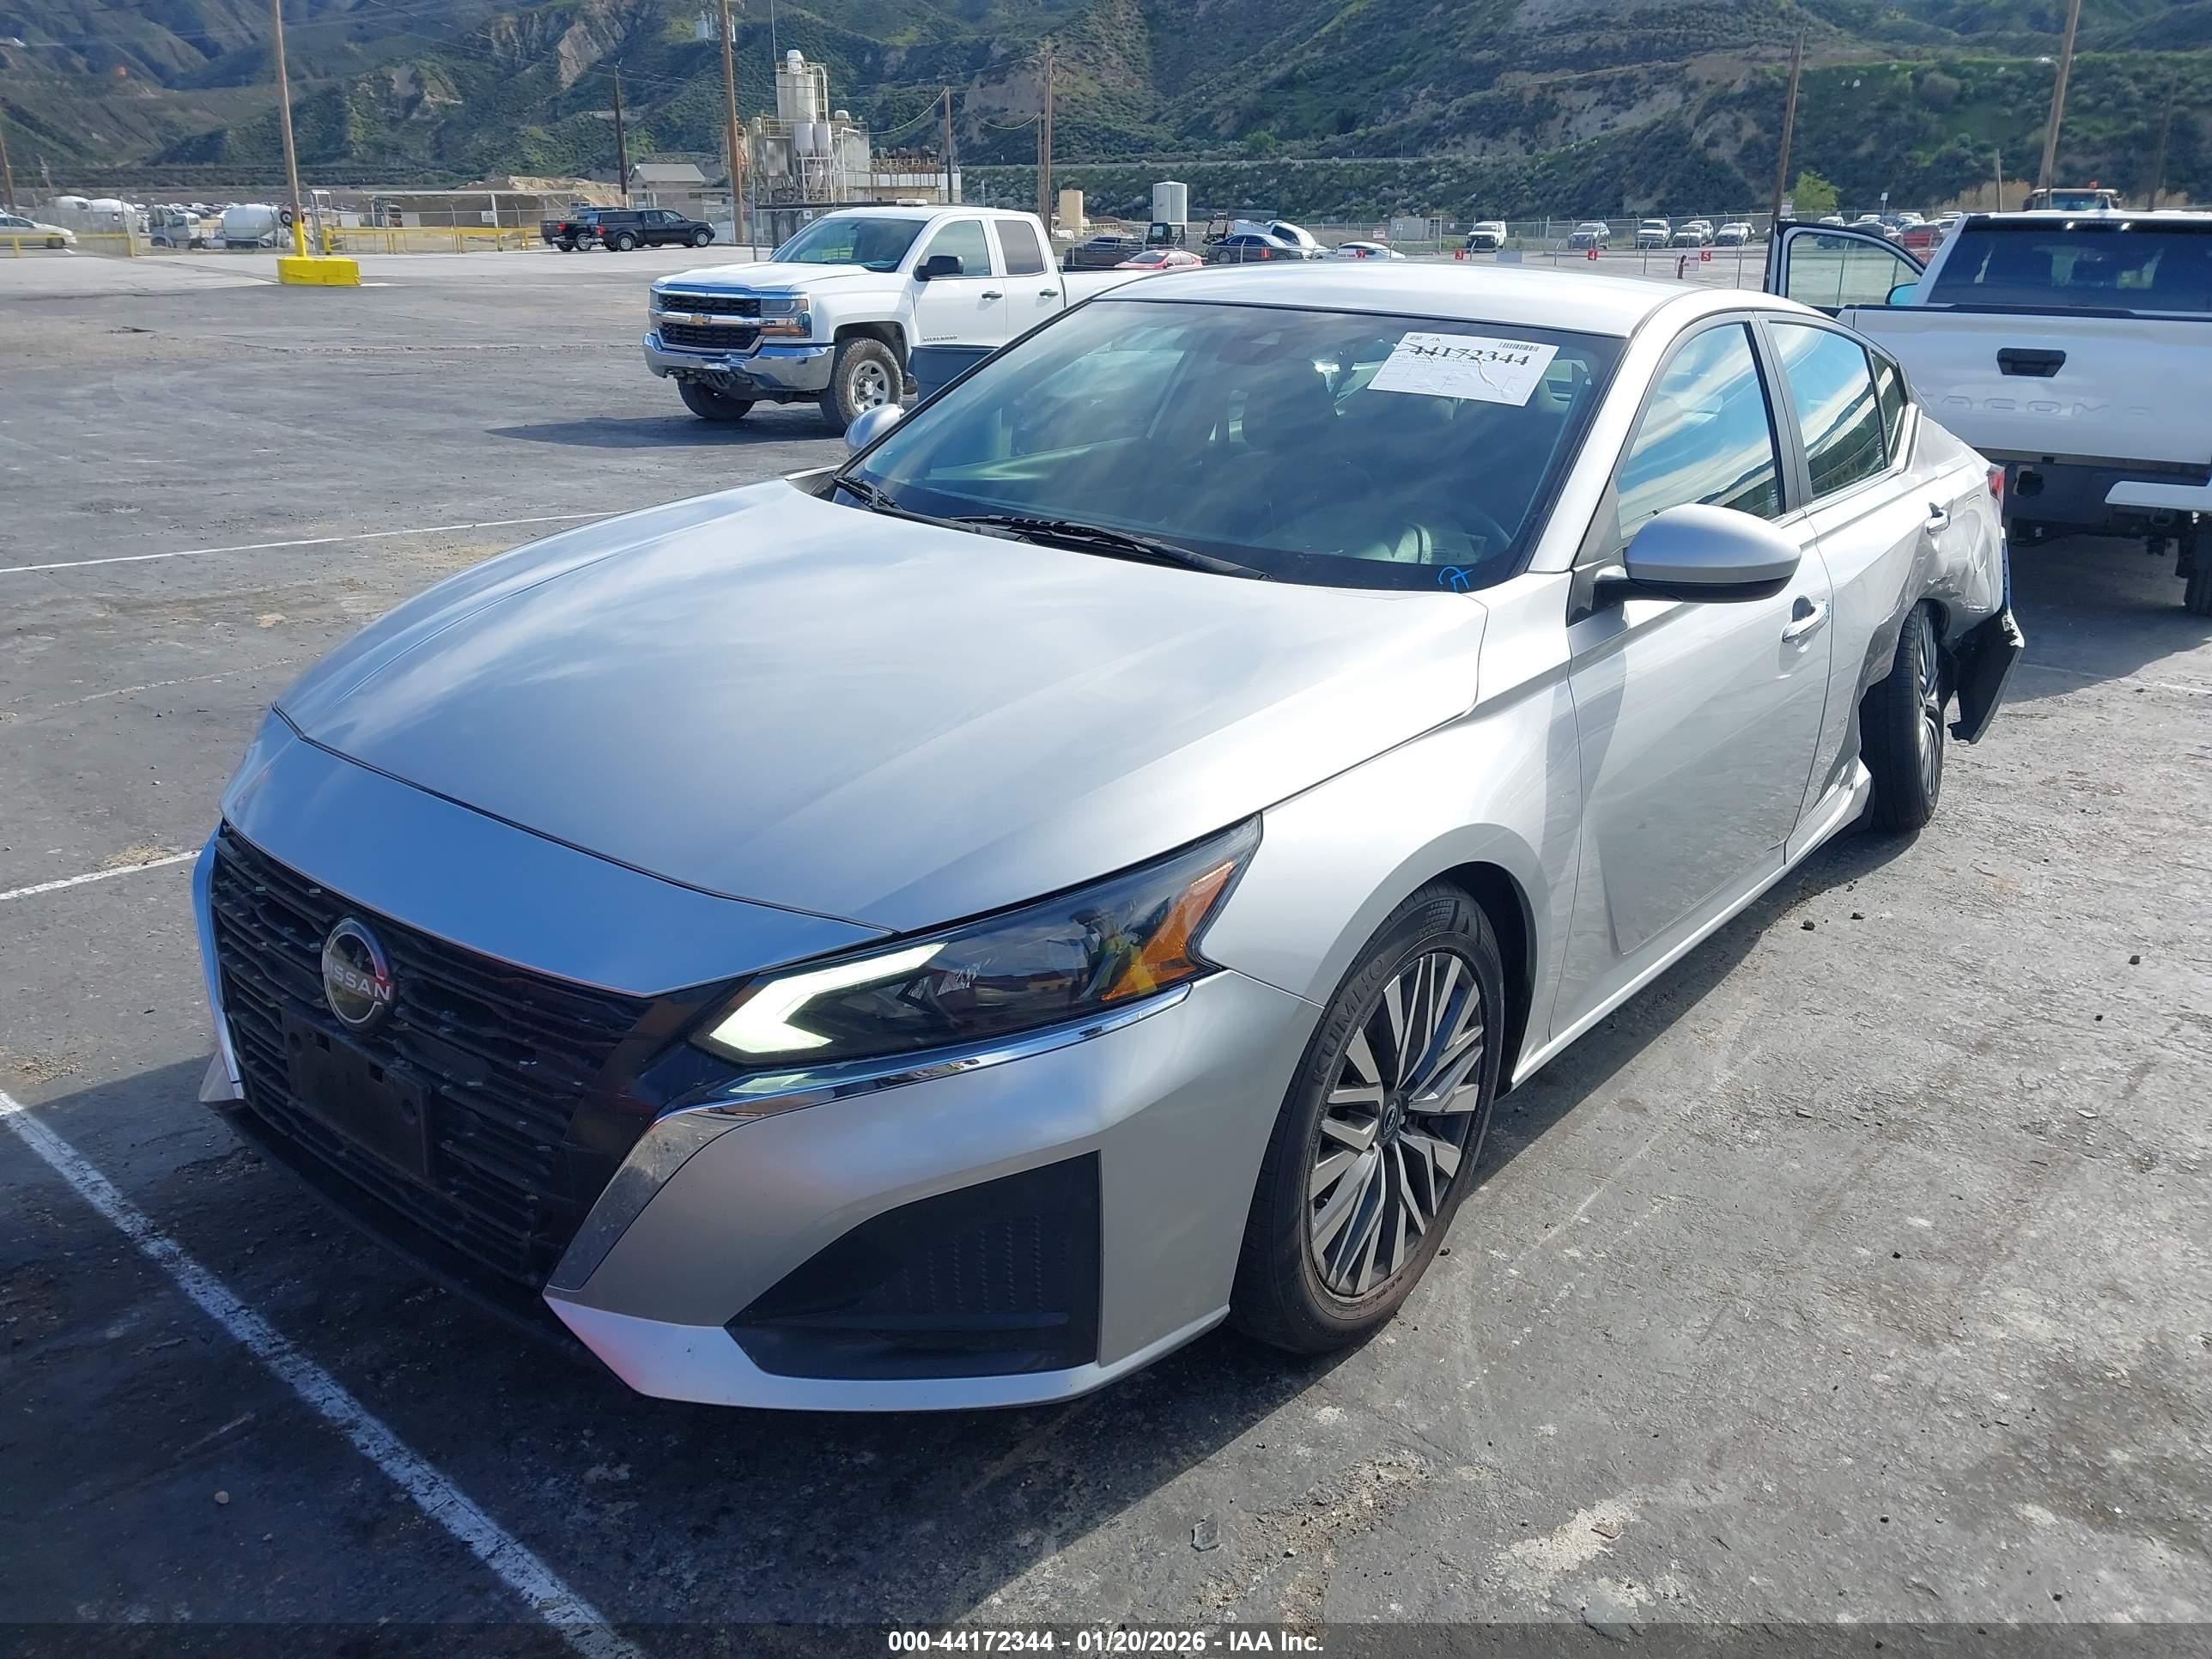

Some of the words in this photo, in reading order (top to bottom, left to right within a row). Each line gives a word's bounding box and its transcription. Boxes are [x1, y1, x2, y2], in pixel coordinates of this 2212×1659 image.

[1703, 252, 1710, 261] 5
[1409, 346, 1530, 366] 44172344
[1312, 959, 1383, 1087] KUMHO
